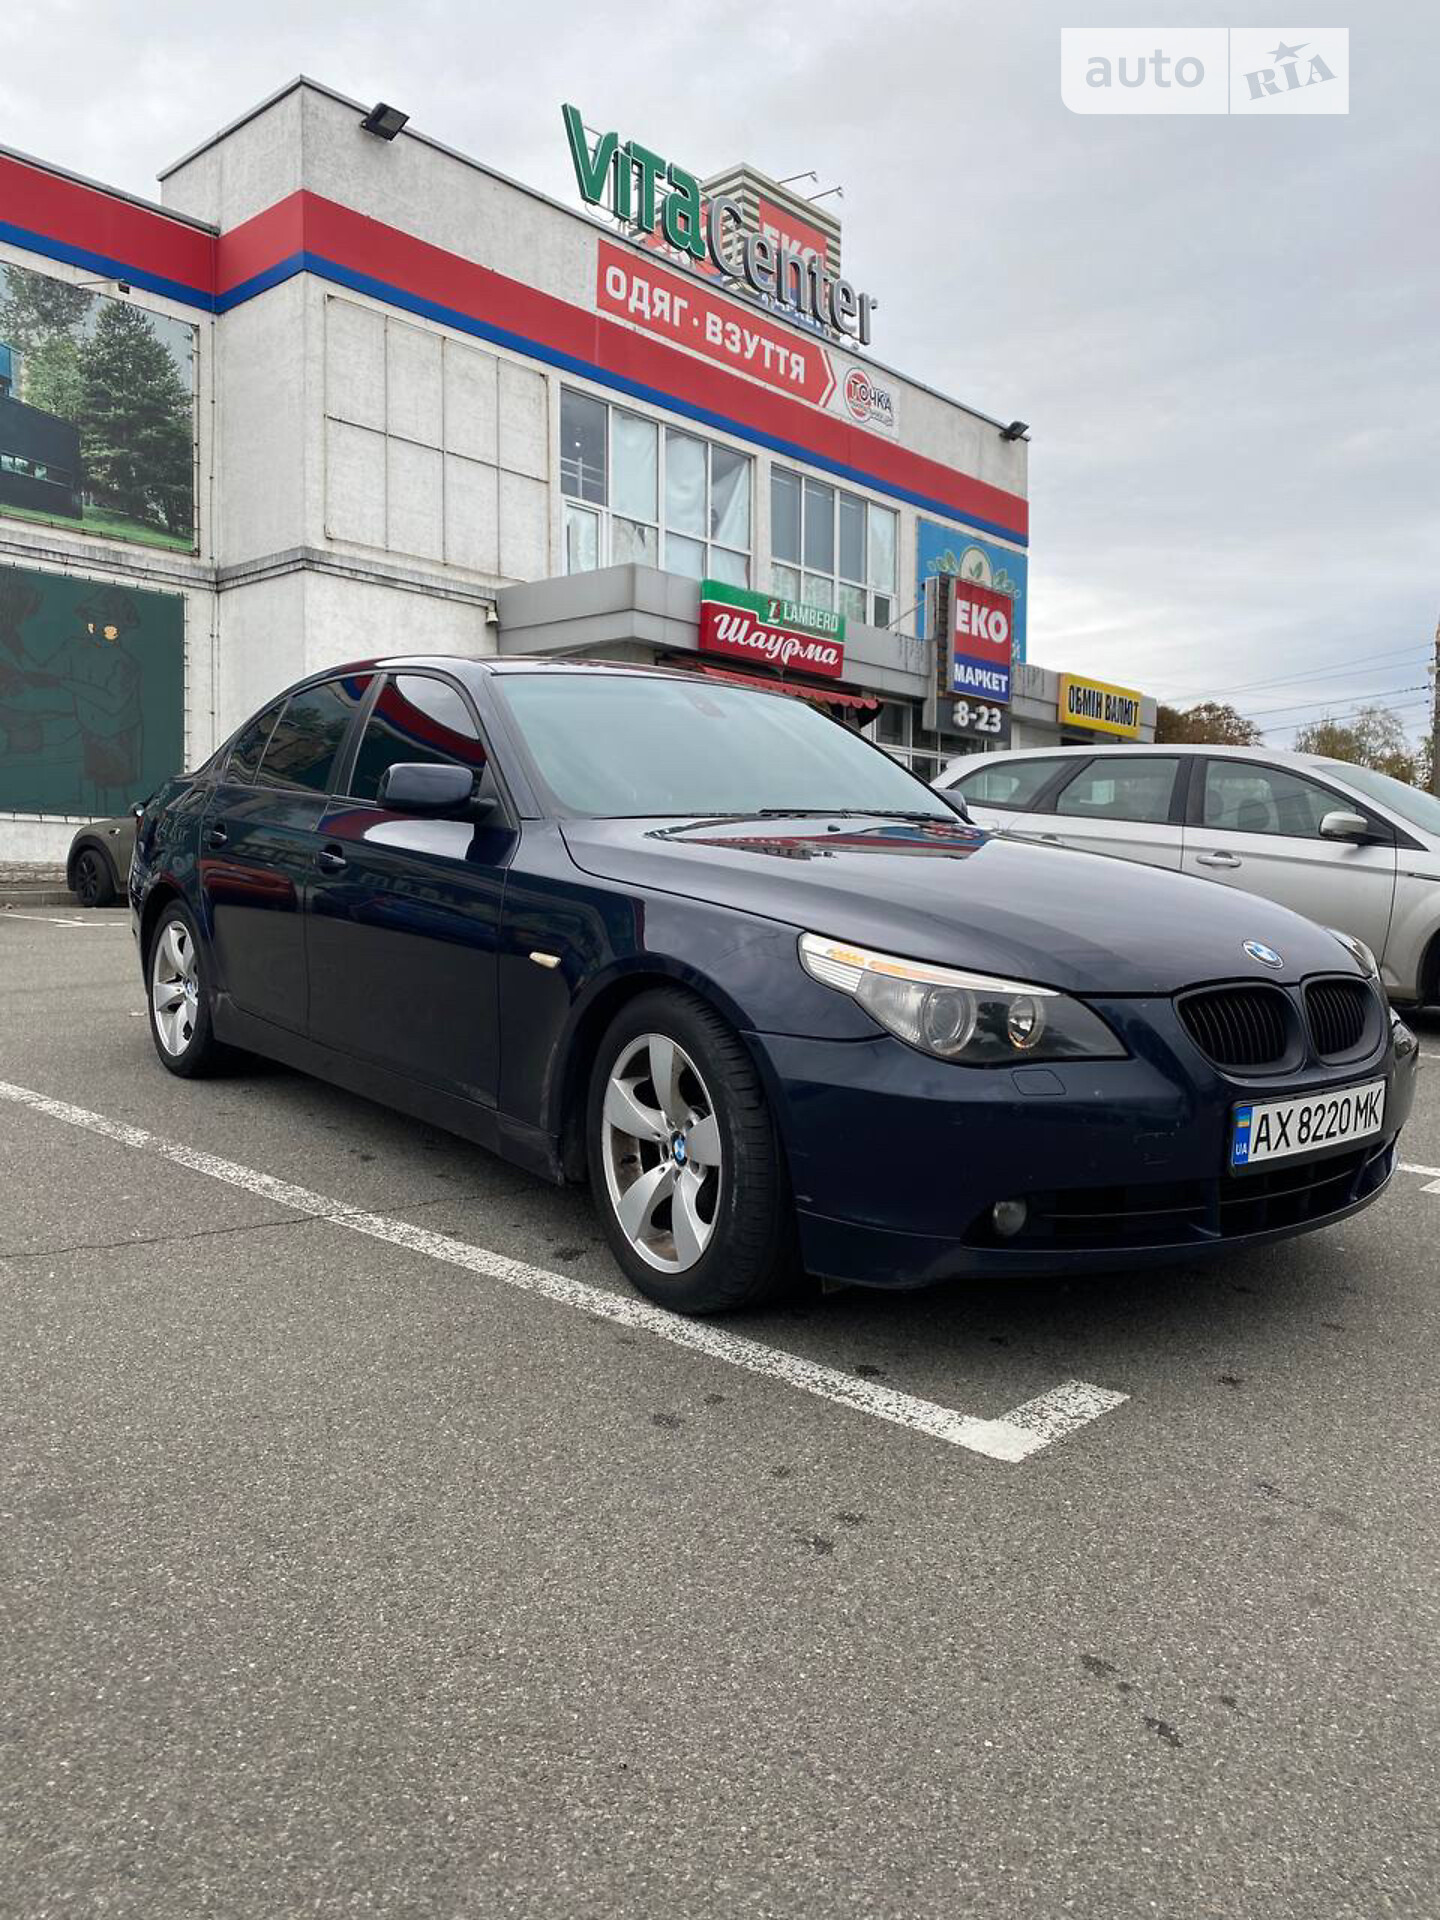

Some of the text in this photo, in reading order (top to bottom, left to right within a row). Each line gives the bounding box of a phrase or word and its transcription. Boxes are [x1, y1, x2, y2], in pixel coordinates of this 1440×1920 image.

[706, 196, 877, 345] Center
[605, 265, 687, 327] ОДЯГ
[705, 311, 805, 384] ВЗУТТЯ
[713, 613, 838, 665] Шаурма
[956, 597, 1008, 643] ЕКО
[954, 662, 1008, 693] МАРКЕТ
[953, 700, 1002, 733] 8-23
[1069, 685, 1139, 728] ОБМІН ВАЛЮТ
[1253, 1088, 1382, 1154] AX 8220 MK
